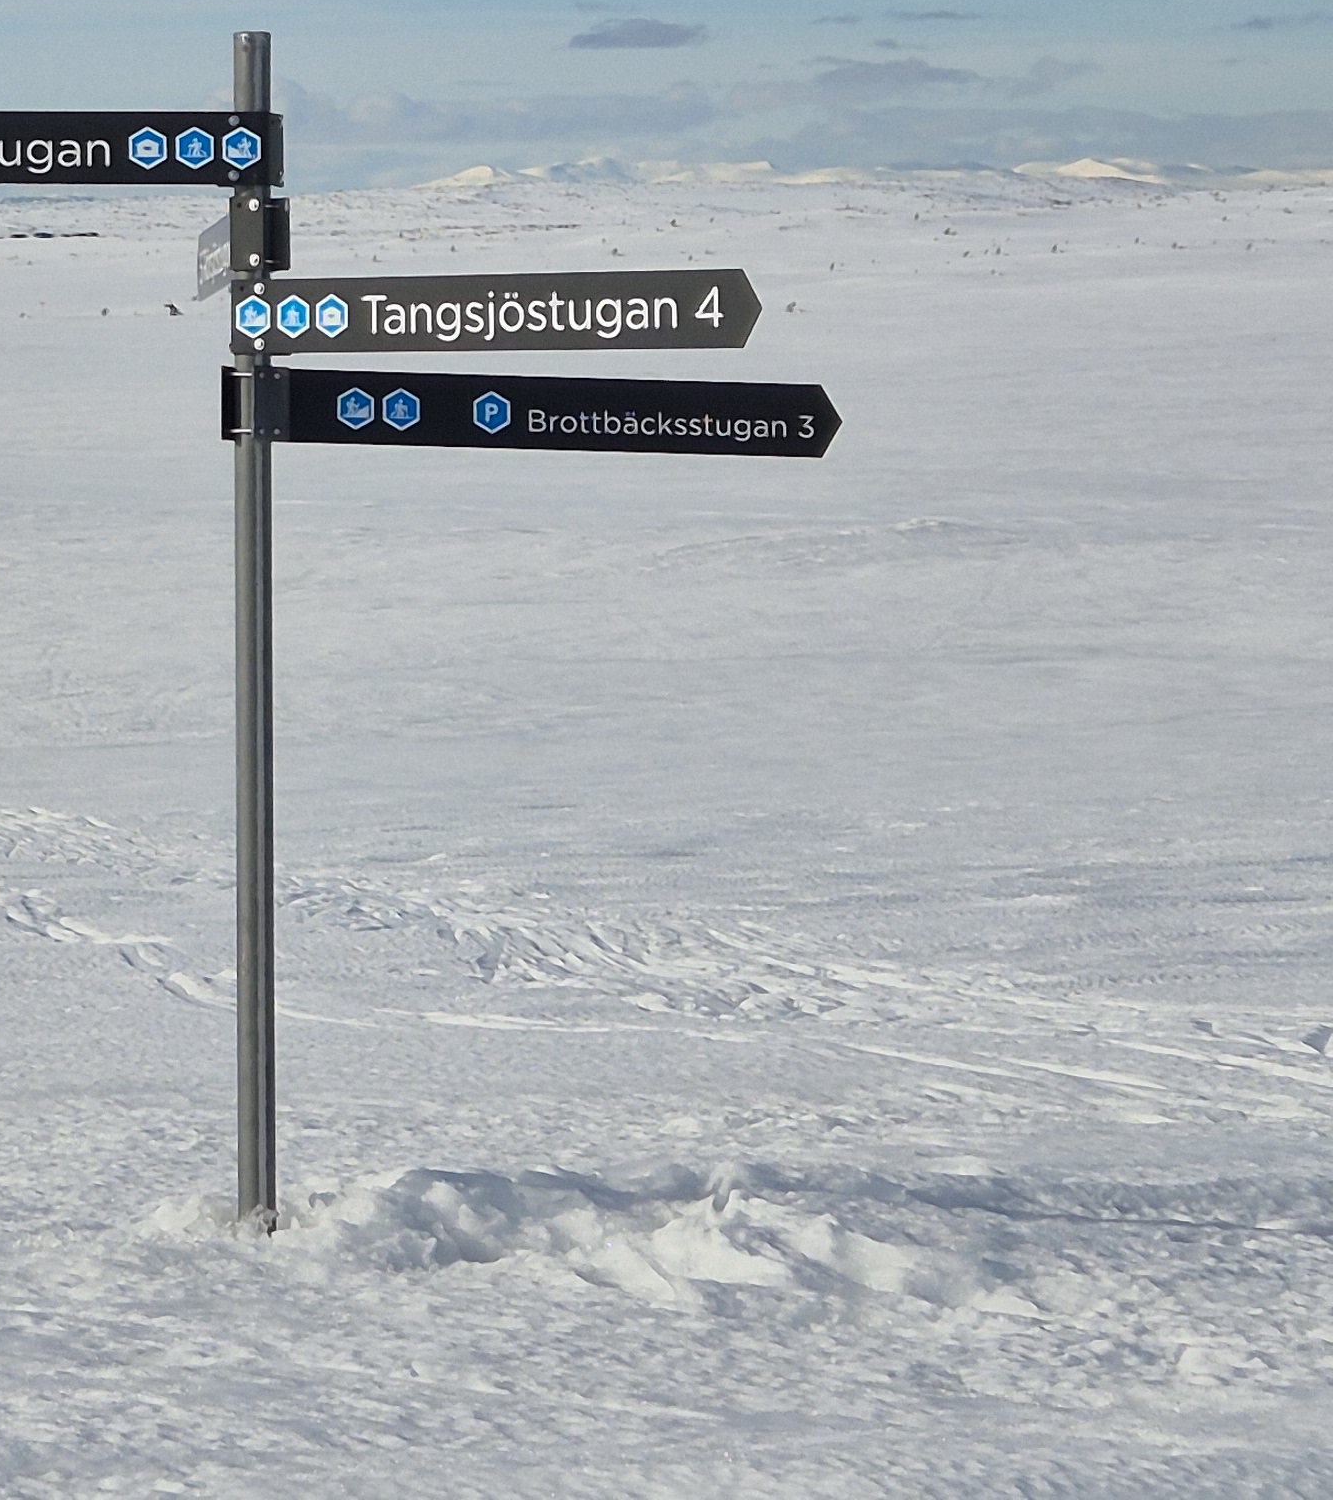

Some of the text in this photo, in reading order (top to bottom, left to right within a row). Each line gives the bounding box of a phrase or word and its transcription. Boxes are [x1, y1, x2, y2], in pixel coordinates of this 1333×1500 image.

[360, 285, 724, 342] Tangsjöstugan 4
[484, 402, 499, 424] P
[528, 409, 815, 442] Brottbäcksstugan 3
